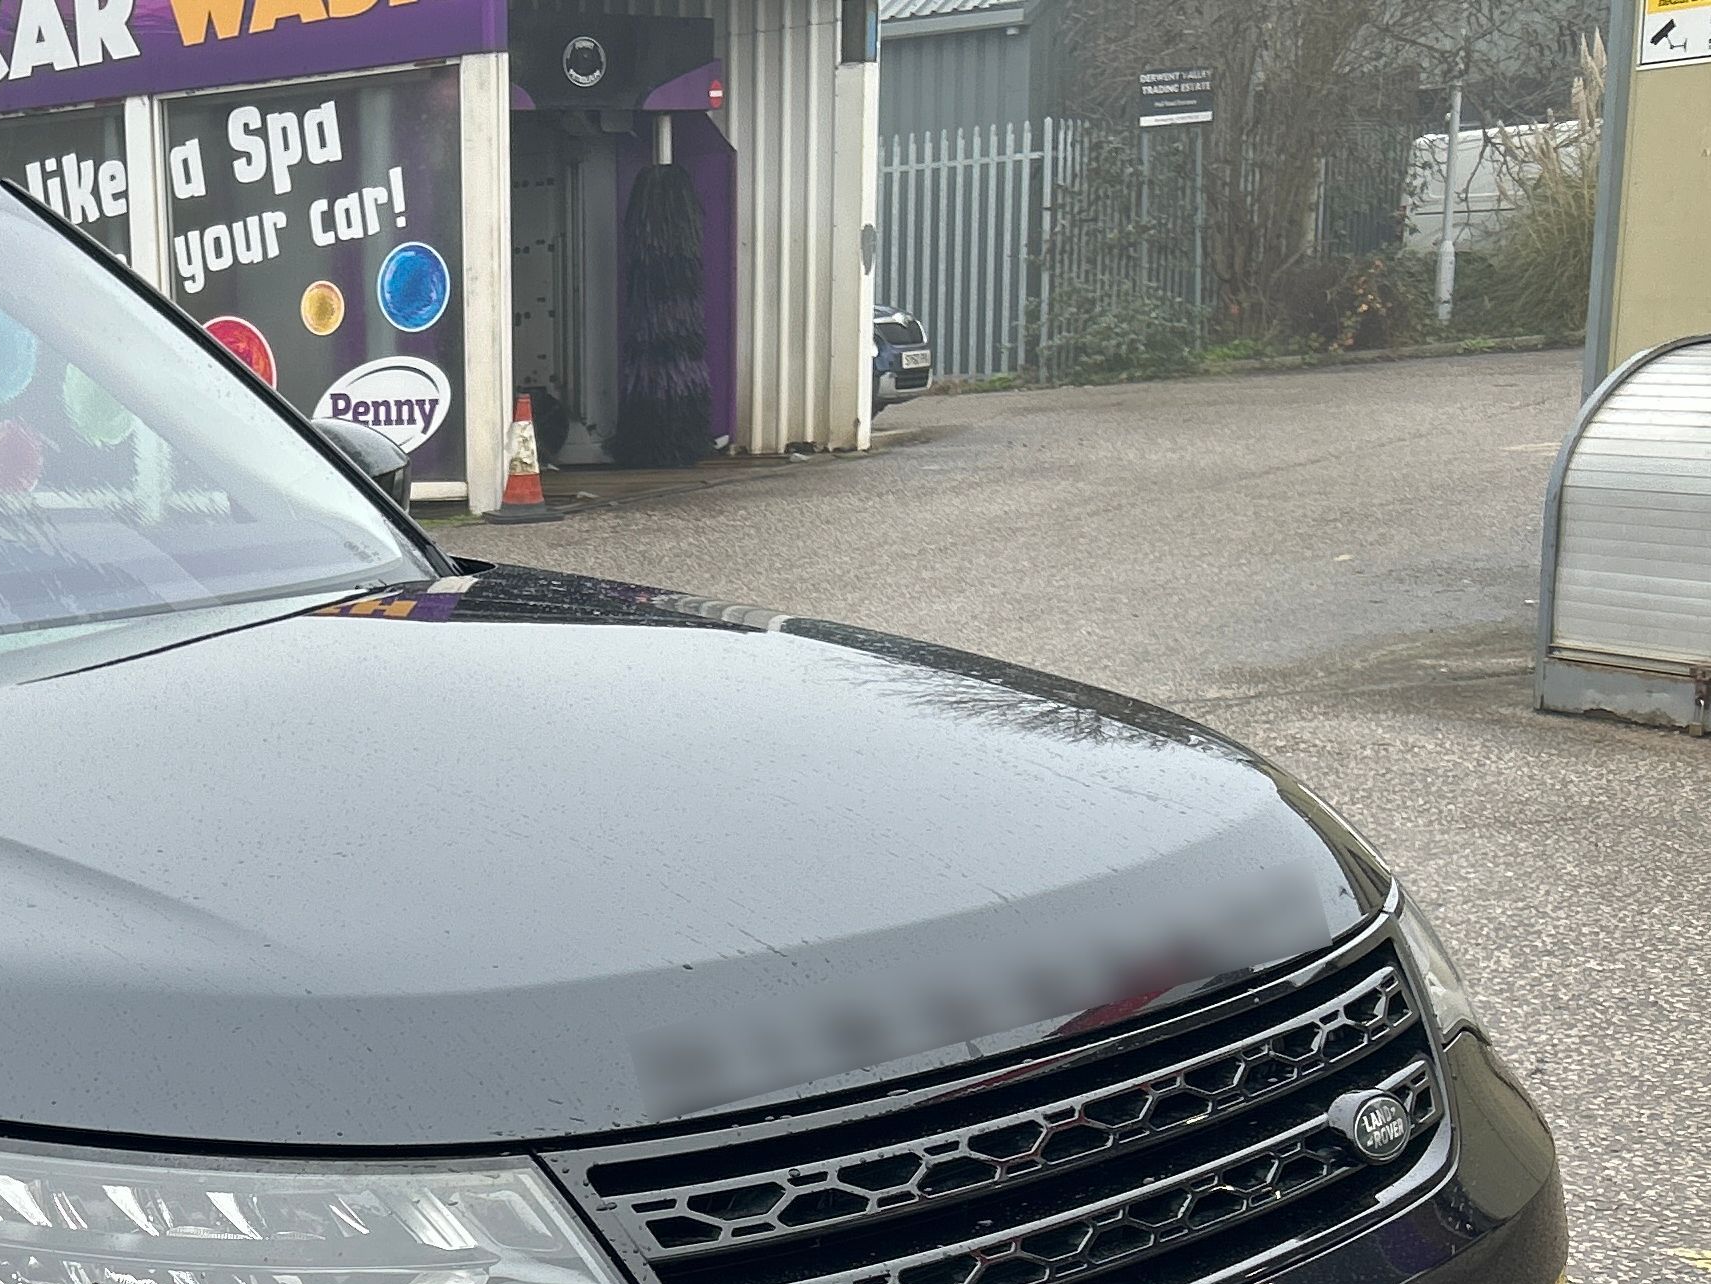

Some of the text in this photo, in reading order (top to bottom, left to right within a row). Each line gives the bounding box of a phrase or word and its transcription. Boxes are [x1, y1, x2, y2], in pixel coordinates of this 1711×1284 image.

[1142, 84, 1179, 94] TRADING
[25, 101, 342, 224] like a Spa
[174, 167, 406, 293] your car!
[330, 393, 439, 435] Penny
[1363, 1105, 1392, 1132] LAND
[1374, 1118, 1405, 1149] ROVER
